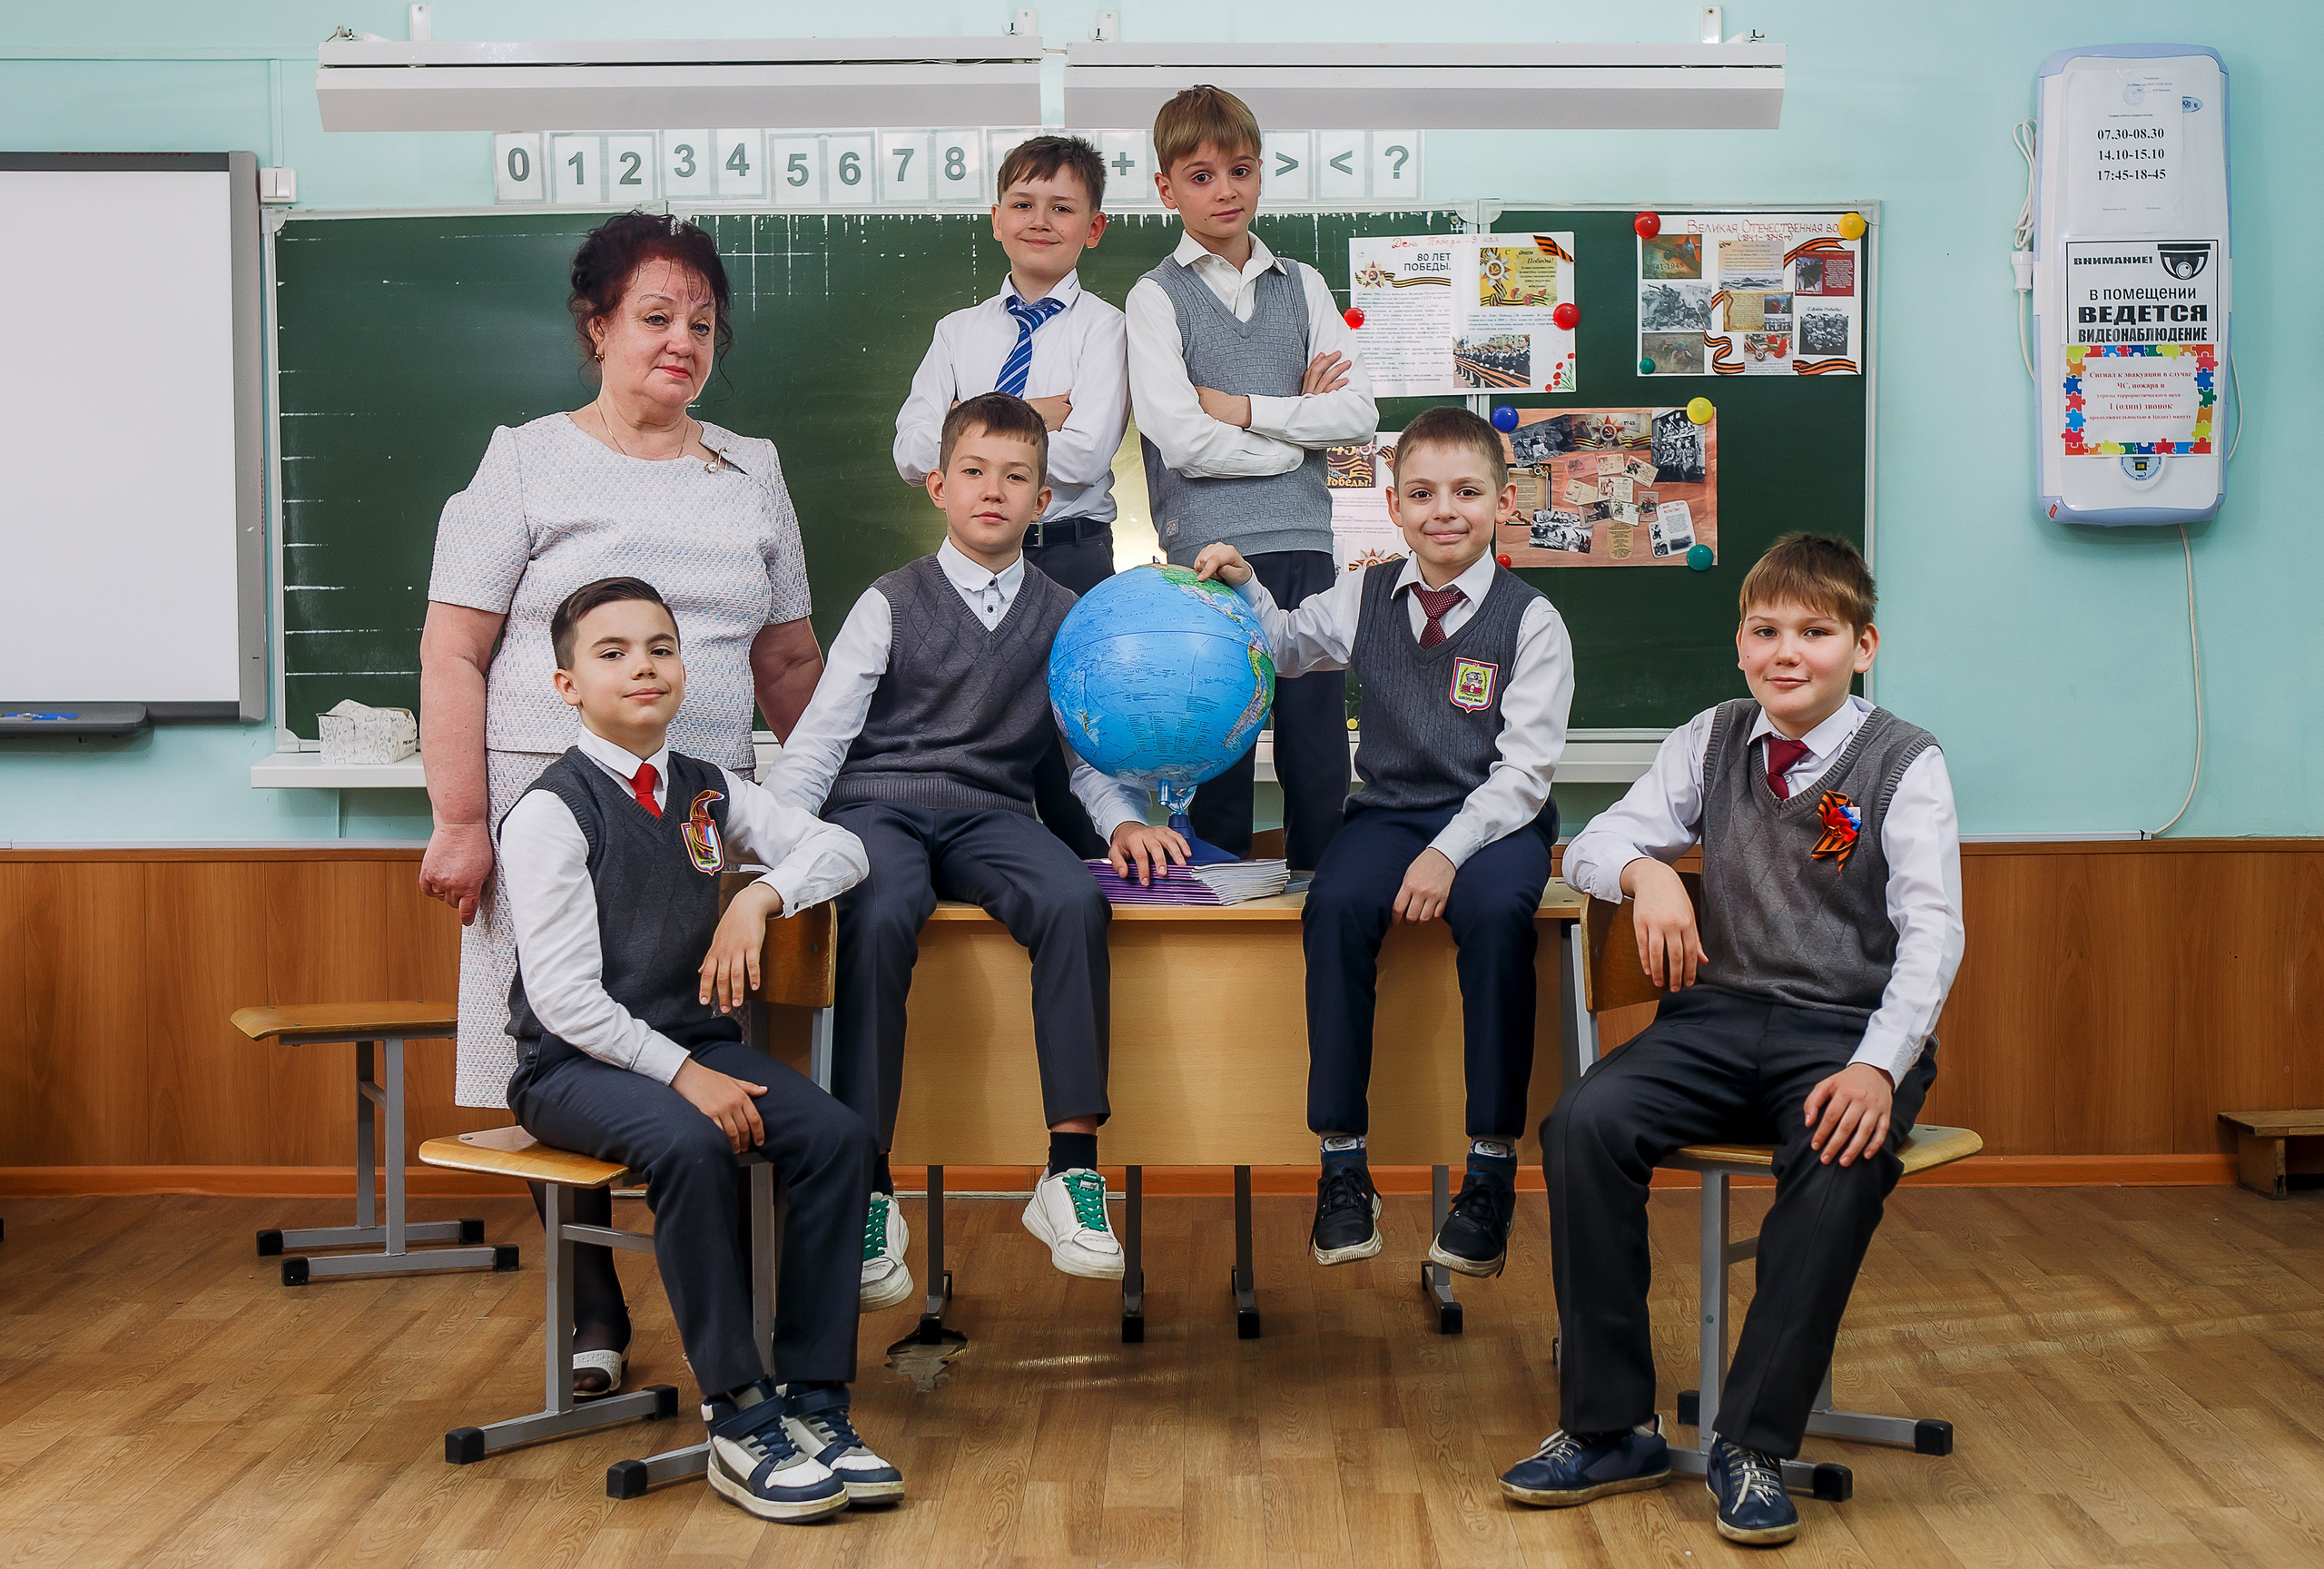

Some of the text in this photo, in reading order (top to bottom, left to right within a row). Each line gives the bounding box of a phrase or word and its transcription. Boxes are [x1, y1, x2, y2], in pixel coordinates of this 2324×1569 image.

[2097, 127, 2165, 140] 07.30-08.30
[2098, 148, 2165, 161] 14.10-15.10
[507, 147, 531, 182] 0
[567, 152, 585, 185] 1
[619, 152, 643, 185] 2
[674, 144, 697, 177] 3
[725, 143, 750, 176] 4
[786, 153, 810, 187] 5
[838, 152, 862, 185] 6
[892, 148, 914, 182] 7
[944, 146, 967, 181] 8
[2097, 169, 2167, 181] 17:45-18-45
[1417, 252, 1452, 262] 80 ЛЕТ
[2073, 256, 2153, 265] ВНИМАНИЕ!
[1403, 262, 1452, 271] ПОБЕДЫ.
[2078, 304, 2208, 325] ВЕДЕТСЯ
[2078, 327, 2208, 343] ВИДЕОНАБЛЮДЕНИЕ
[2115, 402, 2142, 411] (один)
